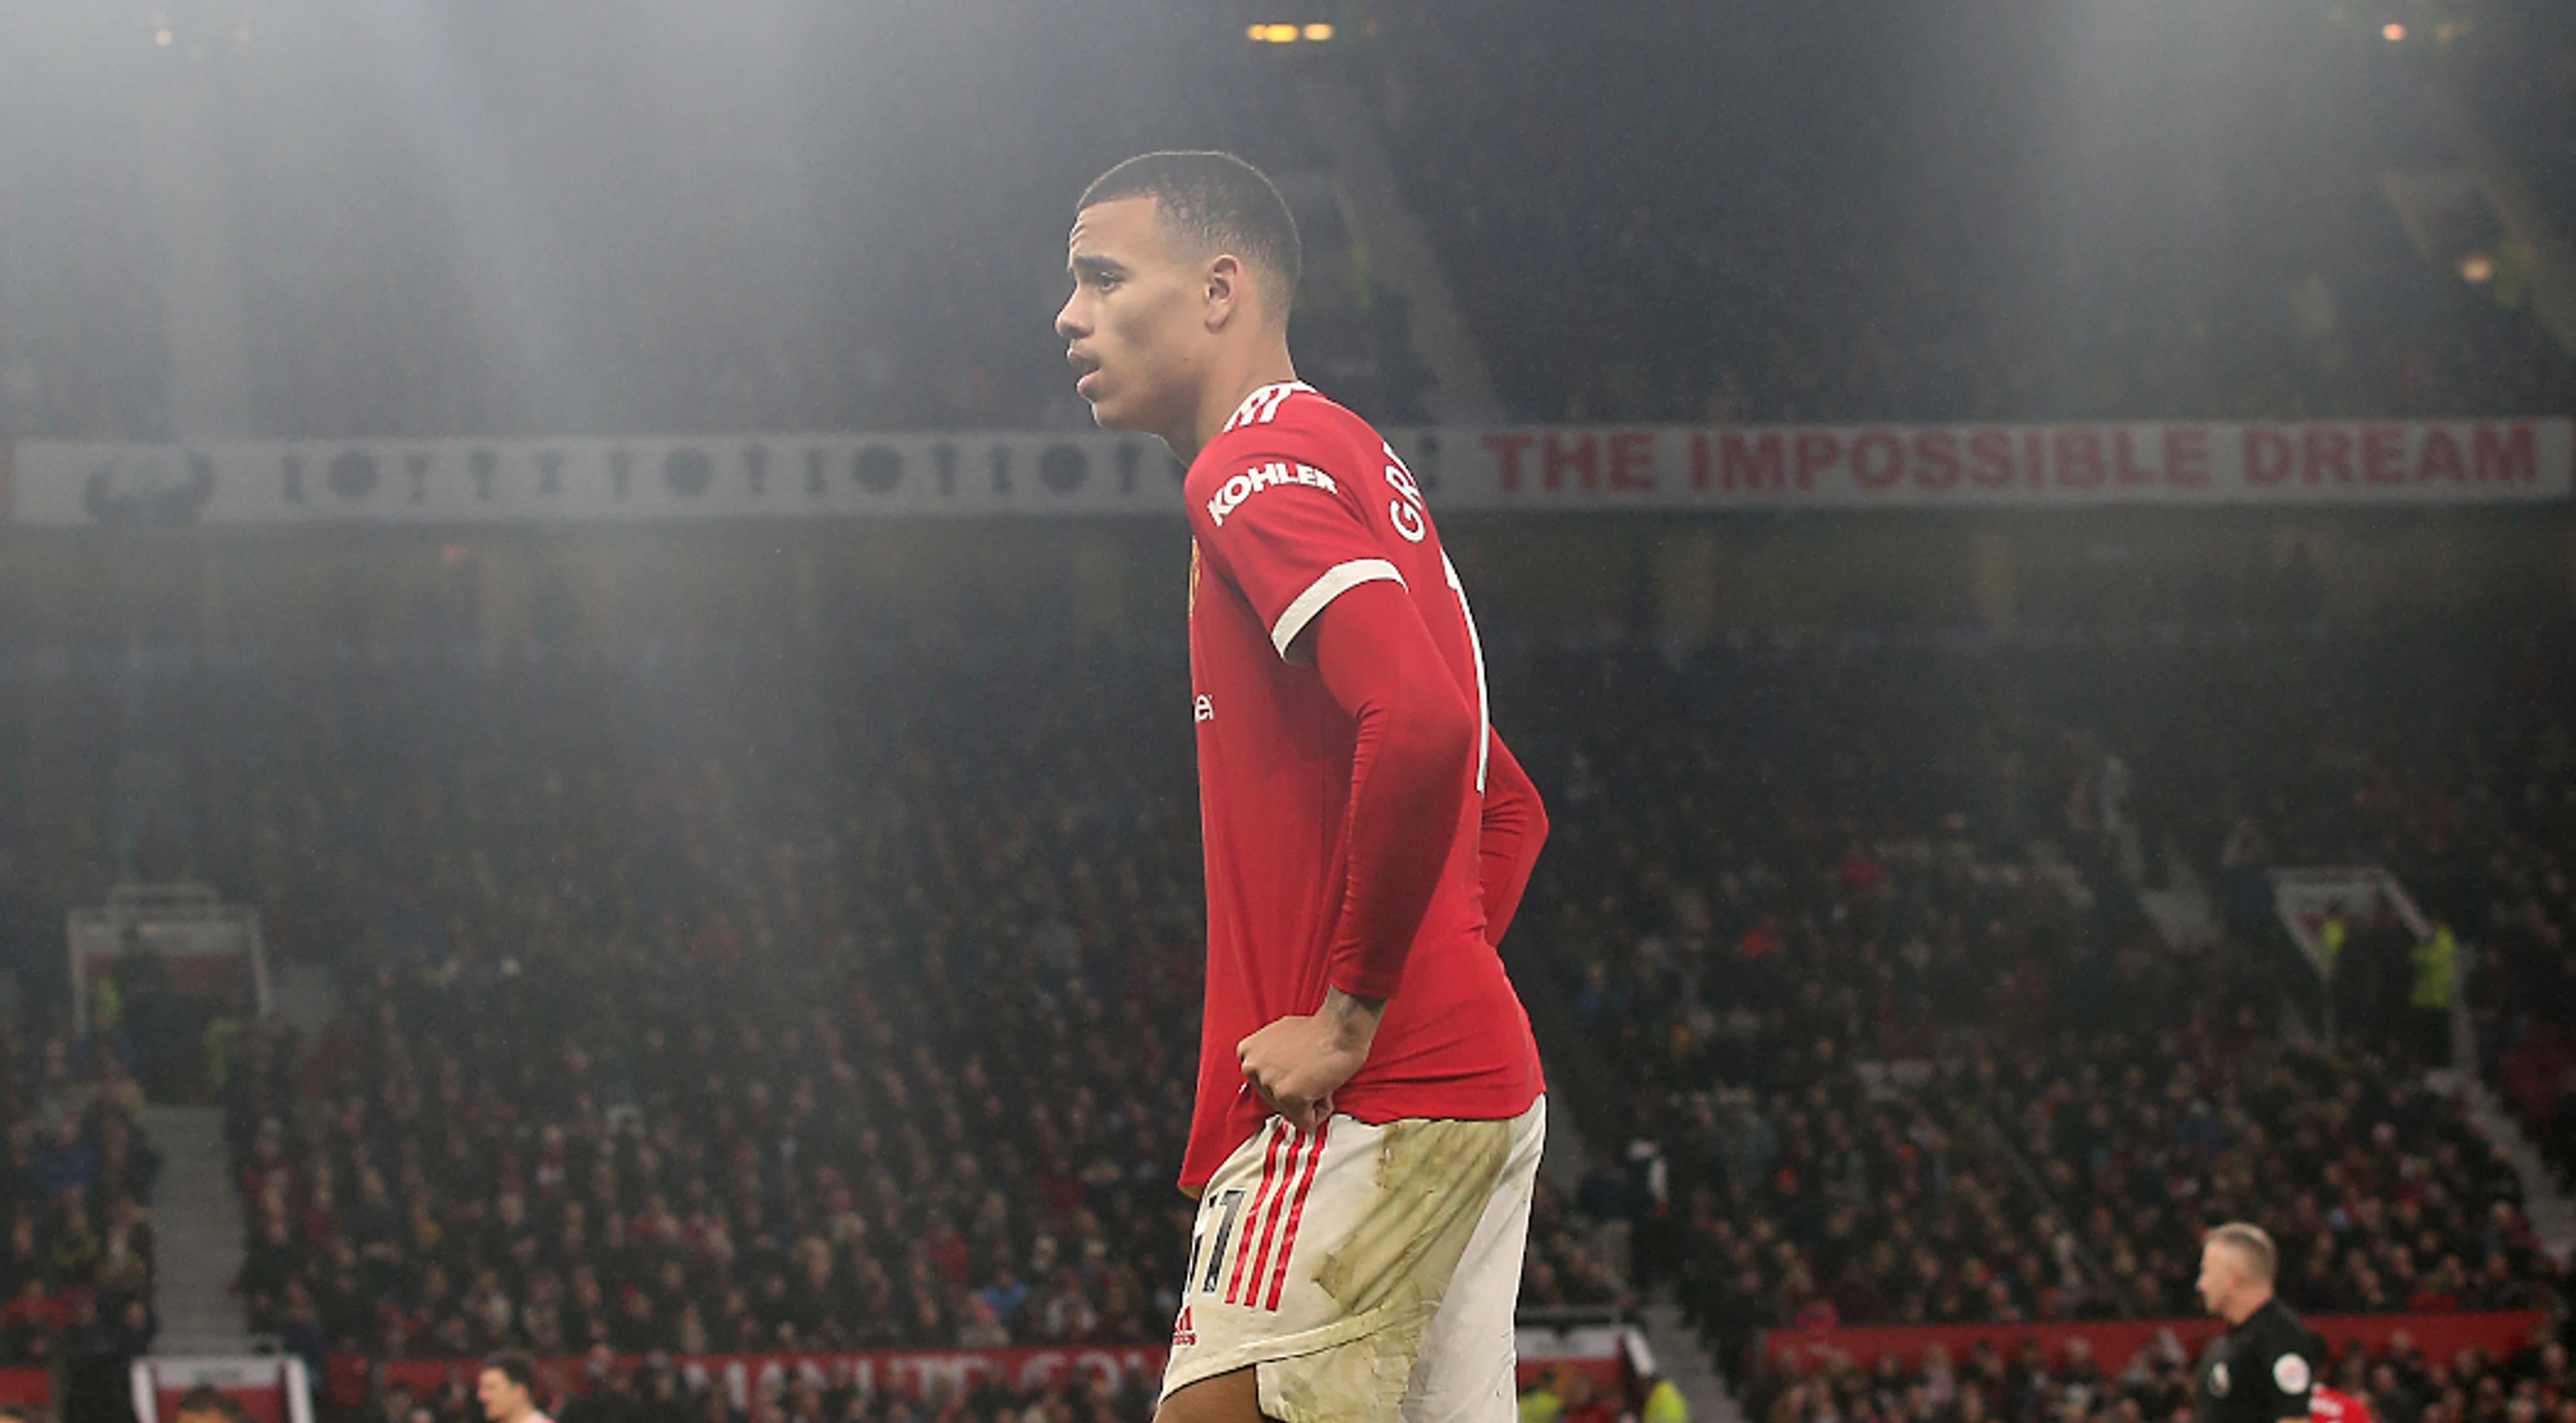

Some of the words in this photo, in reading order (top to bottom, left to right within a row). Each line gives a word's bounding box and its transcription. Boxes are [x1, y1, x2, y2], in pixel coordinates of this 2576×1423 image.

[1481, 432, 1657, 492] THE
[1688, 427, 2213, 491] IMPOSSIBLE
[2241, 424, 2538, 484] DREAM
[1207, 461, 1338, 527] KOHLER
